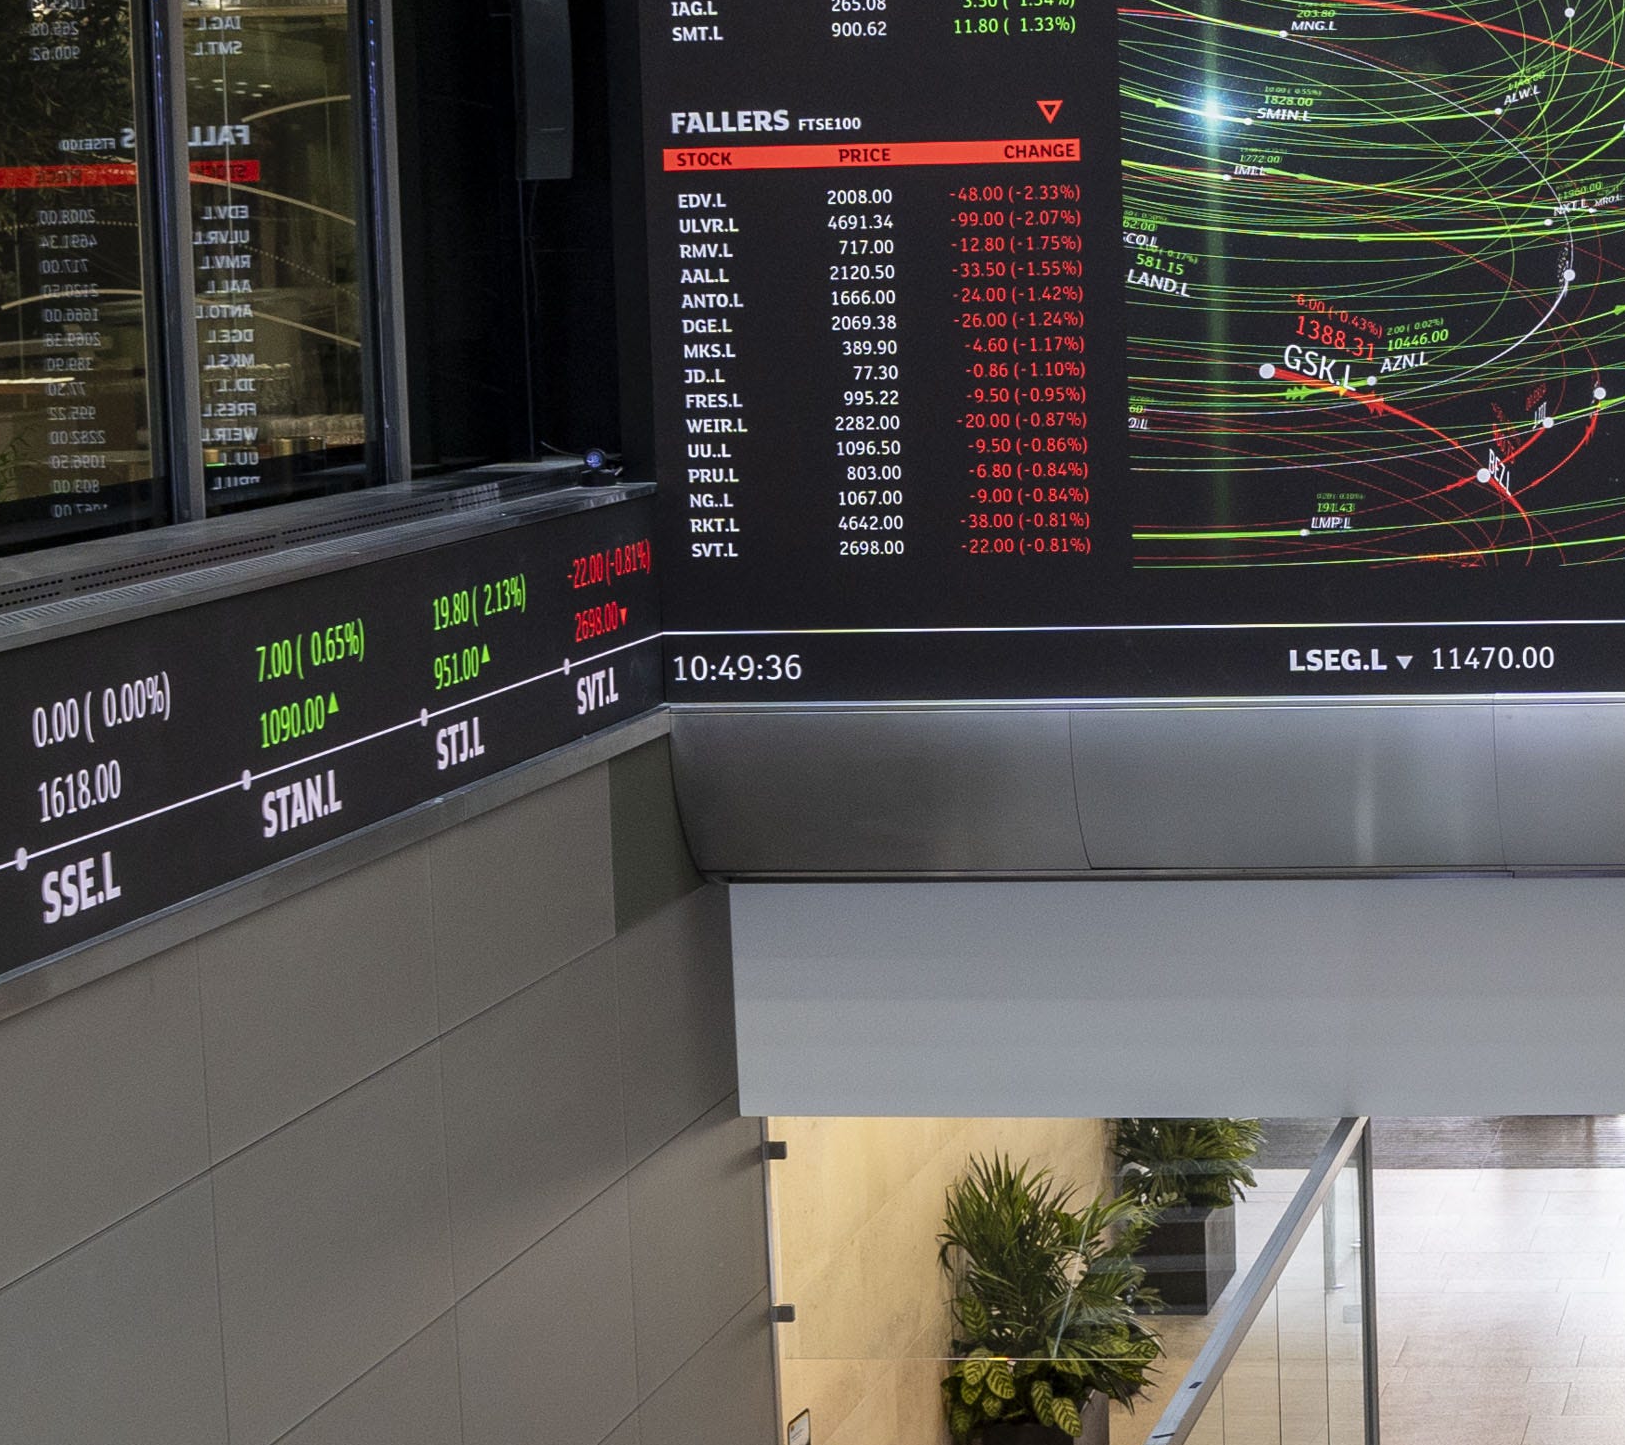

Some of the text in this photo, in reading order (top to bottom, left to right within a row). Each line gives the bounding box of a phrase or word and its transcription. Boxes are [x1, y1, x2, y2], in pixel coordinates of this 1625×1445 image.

[671, 109, 861, 134] FALLERS FTSE100
[678, 144, 1074, 166] STOCK PRICE CHANGE
[678, 185, 1080, 208] EDV.L 2008.00 -48.00 (-2.33%)
[679, 210, 1081, 233] ULVR.L 4691.34 -99.00 (-2.07%)
[1136, 252, 1185, 276] 581.15
[681, 286, 1083, 308] ANTO.L 1666.00 -24.00 (-1.42%)
[1126, 268, 1191, 298] LAND.L
[1295, 315, 1377, 361] 1388.31
[1386, 327, 1449, 350] 10446.00
[1283, 343, 1356, 391] GSK.L
[1381, 350, 1428, 374] AZN.L
[686, 387, 1086, 408] FRES.L 995.22 -9.50 (-0.95%)
[690, 512, 1090, 532] RKT.L 4642.00 -38.00 (-0.81%)
[567, 539, 650, 588] -22.00 (-0.81%)
[575, 601, 619, 642] 2698.00
[434, 646, 479, 689] 951.00
[674, 654, 801, 681] 10:49:36
[1290, 646, 1554, 671] LSEG.L 11470.00
[577, 667, 618, 715] SVT.L
[260, 695, 325, 748] 1090.00
[436, 717, 484, 770] STJ.L
[38, 760, 121, 822] 1618.00
[262, 770, 342, 837] STAN.L
[42, 851, 121, 924] SSE.L
